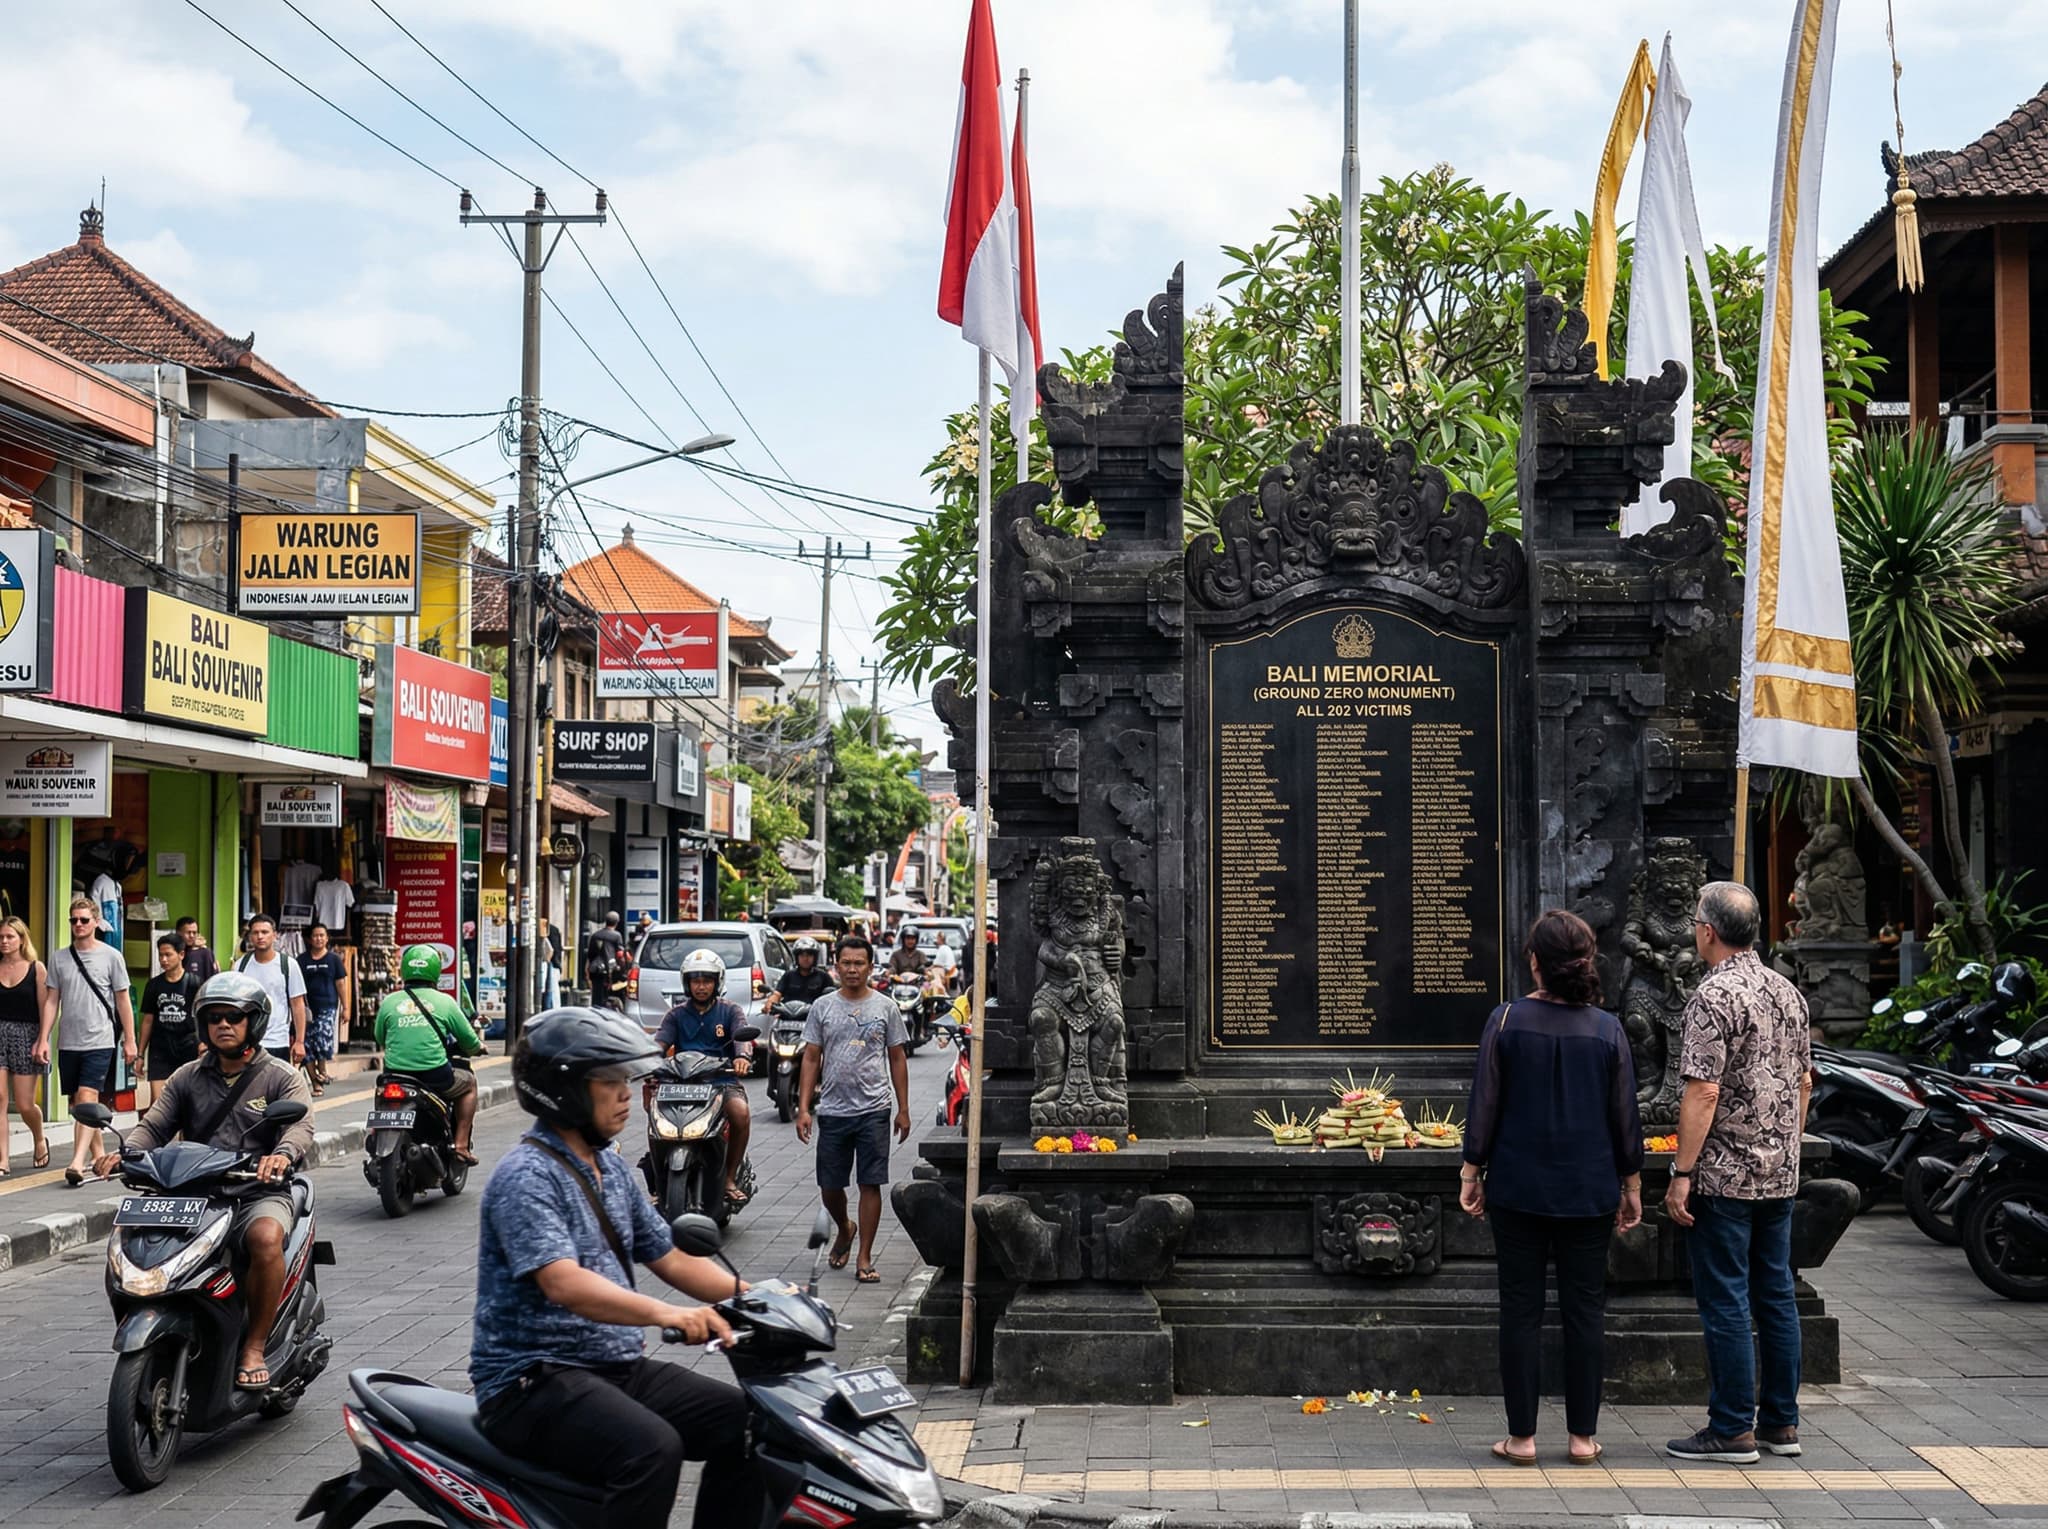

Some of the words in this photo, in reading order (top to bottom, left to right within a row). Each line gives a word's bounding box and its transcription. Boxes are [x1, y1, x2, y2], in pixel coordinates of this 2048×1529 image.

[277, 522, 379, 548] WARUNG
[244, 555, 318, 579] JALAN
[327, 555, 410, 579] LEGIAN
[246, 593, 307, 604] INDONESIAN
[372, 593, 409, 604] LEGIAN
[191, 613, 229, 651] BALI
[152, 639, 187, 685] BALI
[191, 650, 263, 704] SOUVENIR
[1267, 665, 1317, 682] BALI
[1323, 665, 1441, 682] MEMORIAL
[602, 677, 642, 689] WARUNG
[679, 677, 714, 690] LEGIAN
[1253, 687, 1320, 702] (GROUND
[1324, 687, 1364, 699] ZERO
[1367, 687, 1456, 701] MONUMENT)
[400, 679, 427, 722] BALI
[430, 687, 485, 735] SOUVENIR
[1296, 704, 1324, 717] ALL
[1327, 704, 1351, 717] 202
[1355, 704, 1412, 717] VICTIMS
[558, 730, 602, 751] SURF
[605, 731, 649, 752] SHOP
[41, 777, 96, 790] SOUVENIR
[267, 801, 286, 811] BALI
[287, 801, 332, 812] SOUVENIR
[122, 1199, 132, 1212] B
